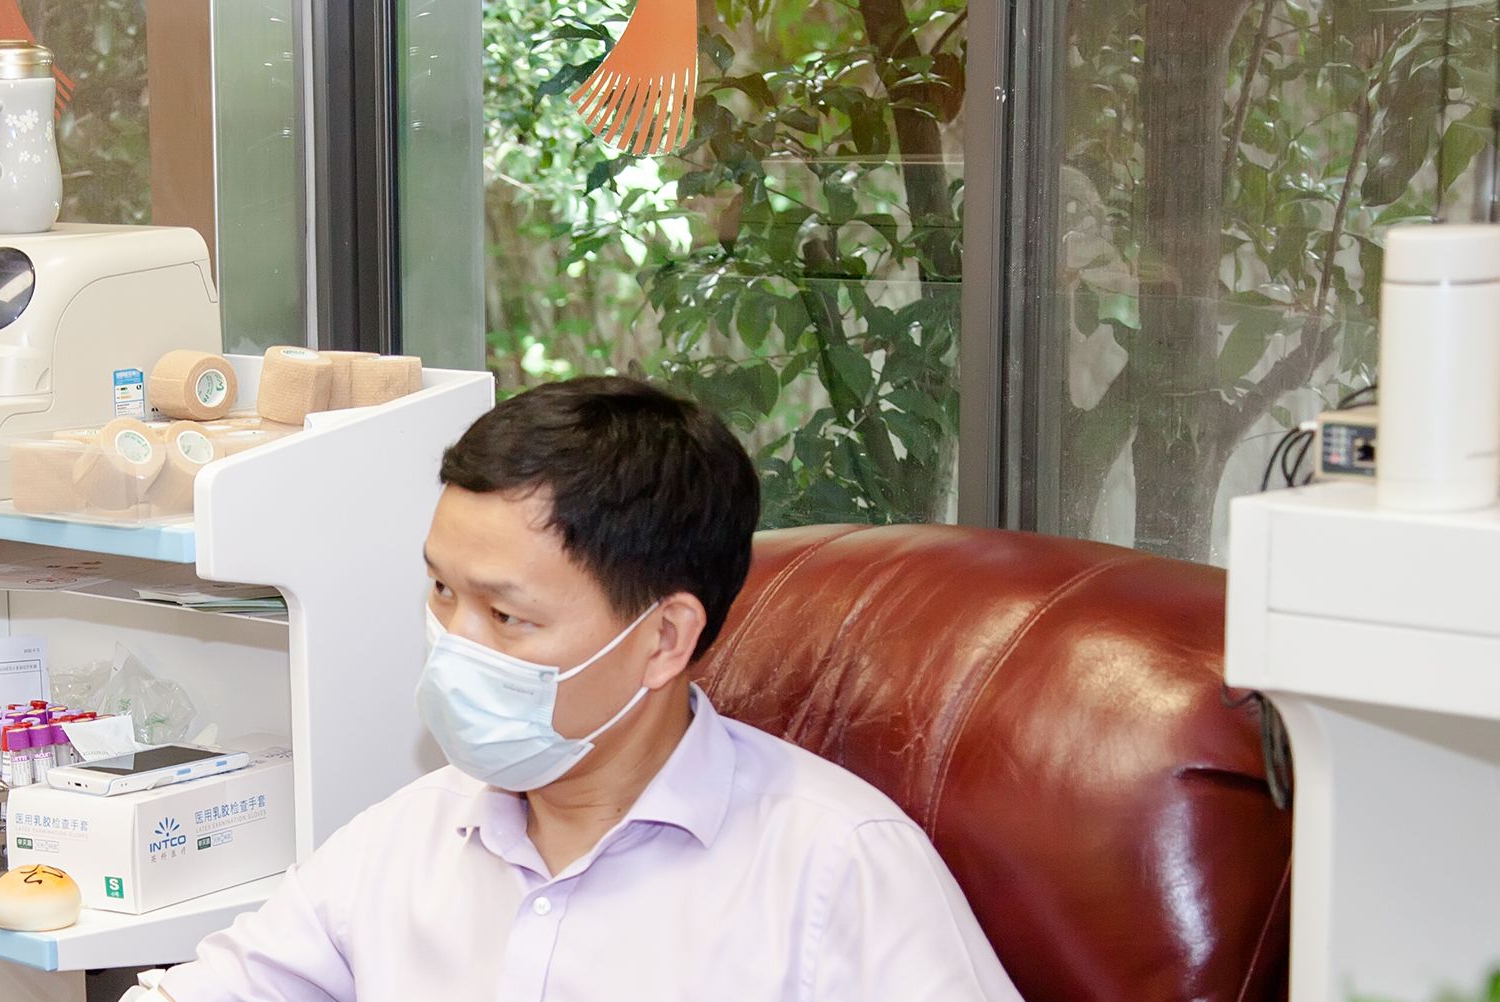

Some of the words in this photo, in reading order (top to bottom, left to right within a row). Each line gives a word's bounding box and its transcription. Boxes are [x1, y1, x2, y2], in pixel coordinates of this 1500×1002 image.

[195, 794, 265, 825] 医用乳胶检查手套
[15, 813, 89, 832] 医用乳胶检查手套
[149, 835, 187, 853] INTCO
[109, 878, 119, 891] S
